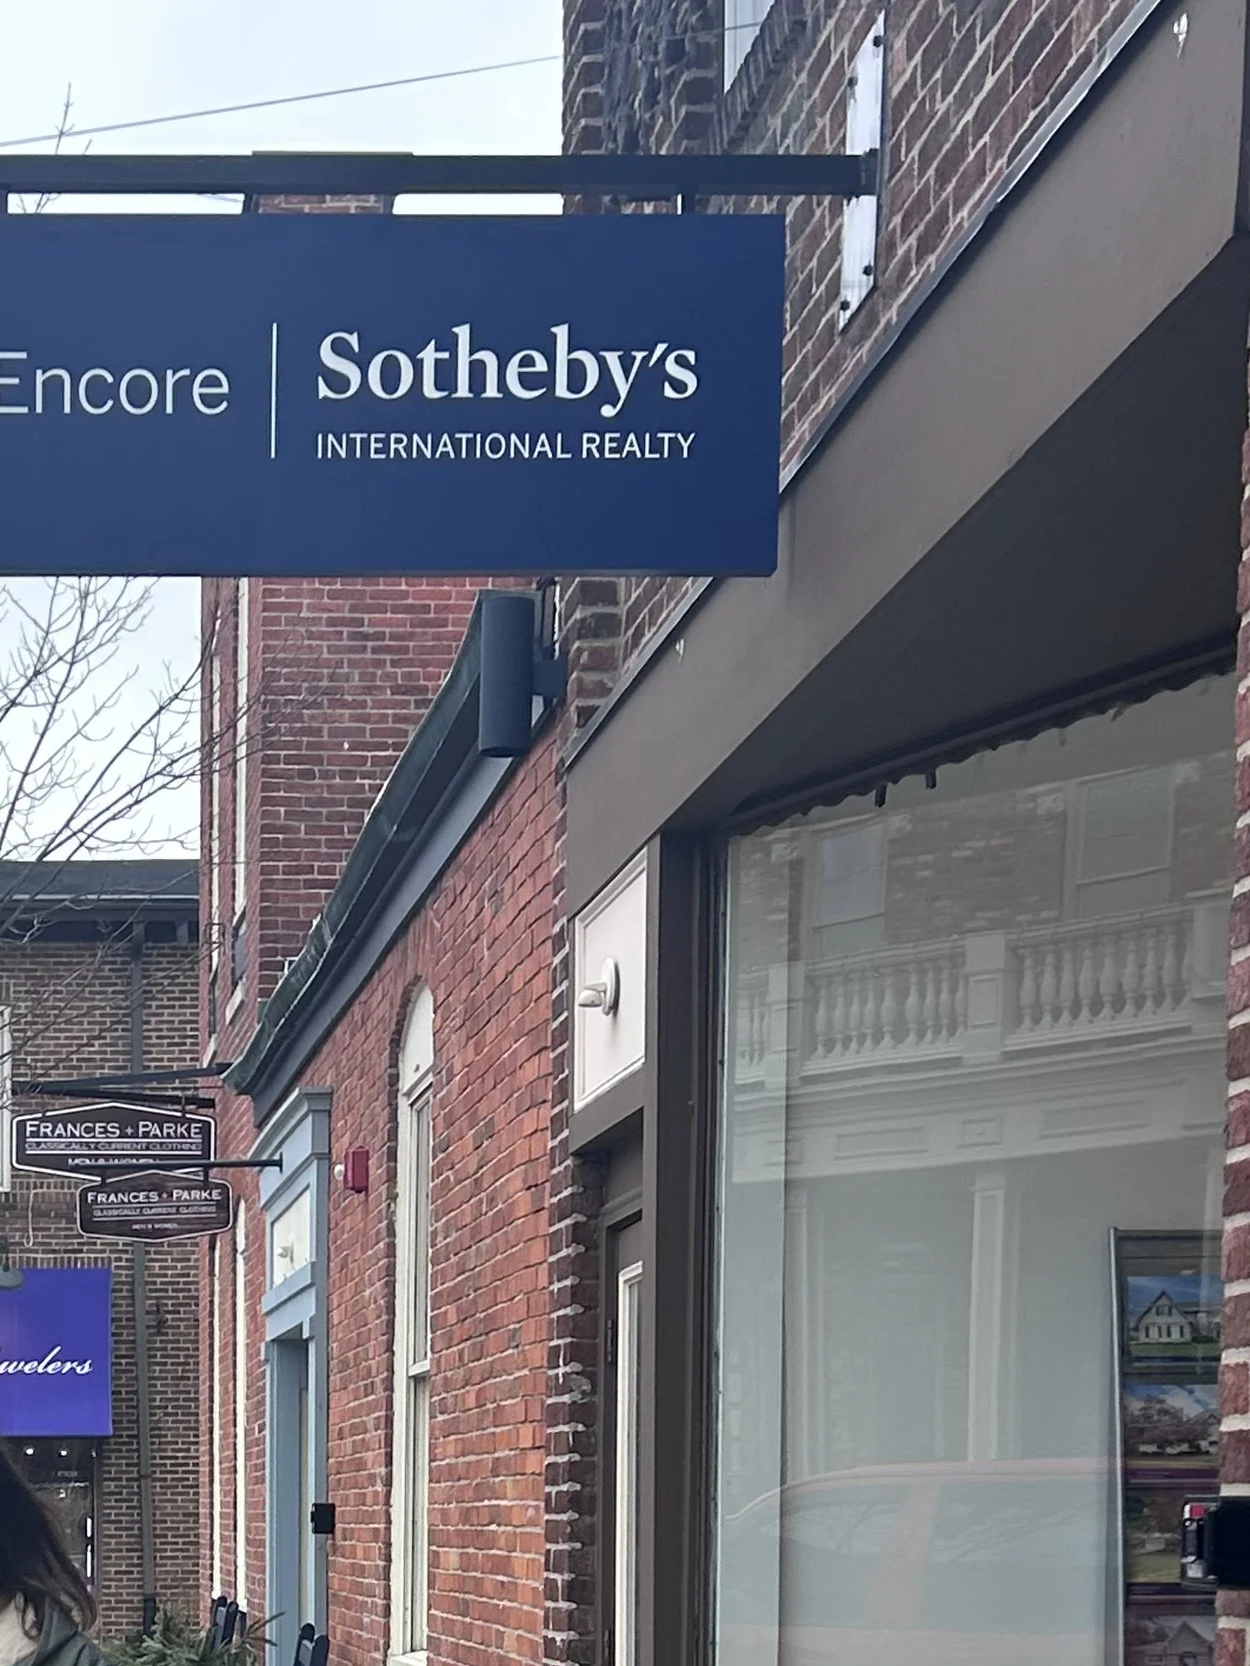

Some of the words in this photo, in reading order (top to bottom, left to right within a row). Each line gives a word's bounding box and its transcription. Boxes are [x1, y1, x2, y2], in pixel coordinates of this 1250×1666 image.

[316, 322, 699, 418] Sotheby's
[316, 432, 573, 460] INTERNATIONAL
[581, 432, 697, 459] REALTY
[25, 1120, 120, 1138] FRANCES
[125, 1126, 134, 1137] +
[138, 1120, 203, 1138] PARKE
[24, 1142, 95, 1151] CLASSICALLY
[97, 1142, 148, 1151] CURRENT
[149, 1142, 203, 1151] CLOTHING
[87, 1190, 159, 1204] FRANCES
[172, 1188, 222, 1201] PARKE
